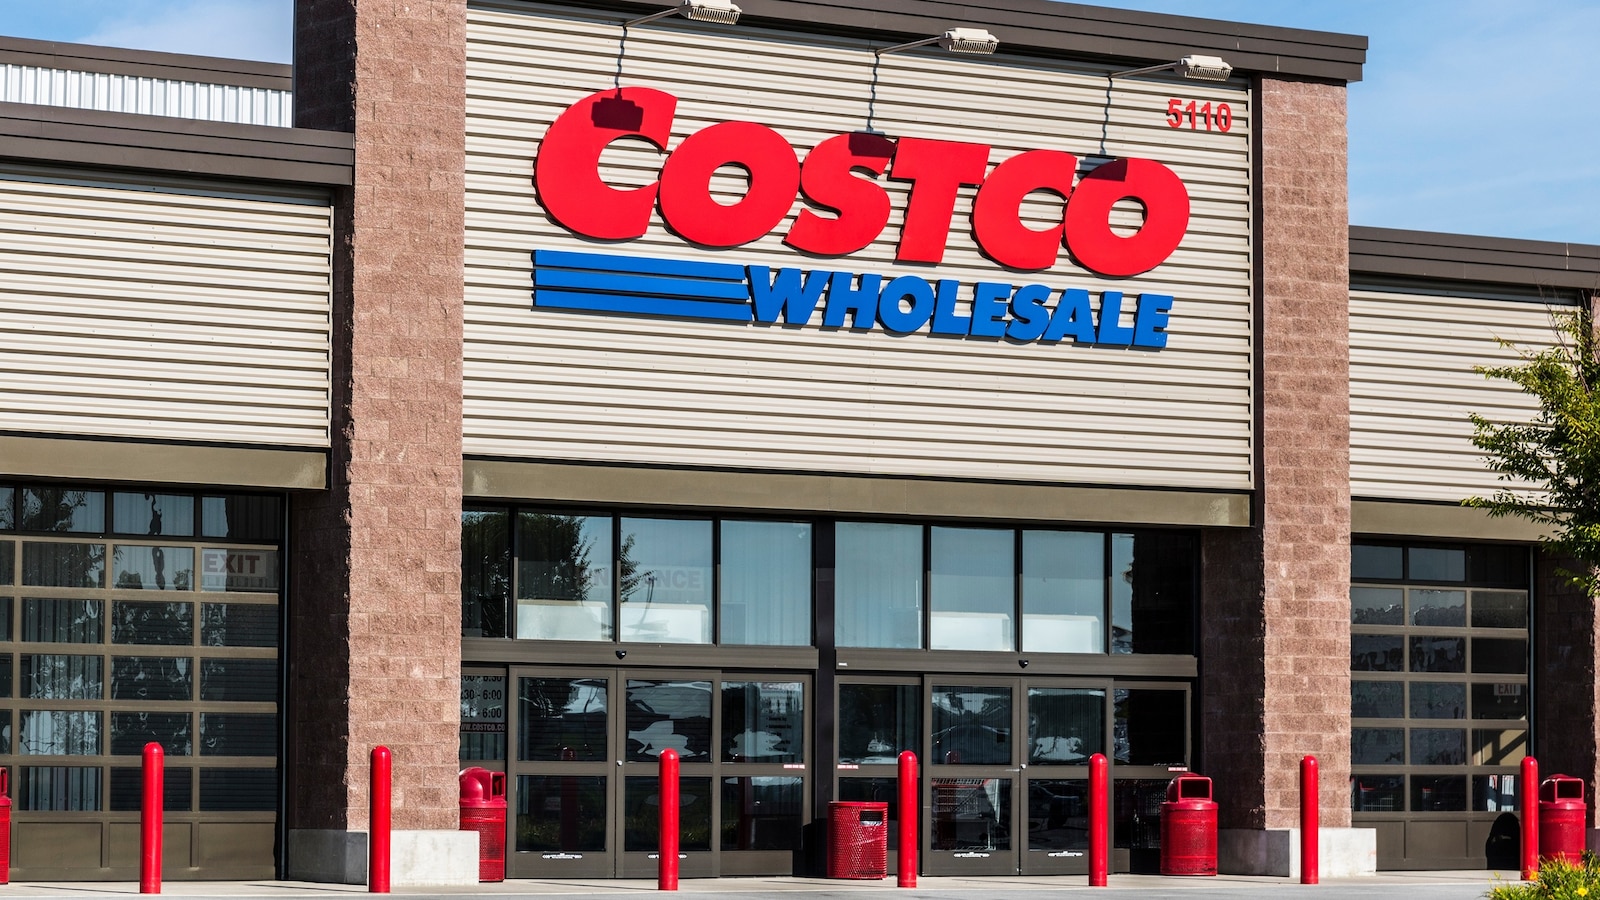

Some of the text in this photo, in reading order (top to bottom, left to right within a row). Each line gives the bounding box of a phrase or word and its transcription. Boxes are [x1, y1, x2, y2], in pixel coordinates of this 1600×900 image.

[1167, 98, 1232, 133] 5110
[535, 86, 1190, 277] COSTCO
[747, 265, 1174, 348] WHOLESALE
[204, 553, 261, 574] EXIT
[483, 690, 502, 700] 6:00
[1498, 683, 1517, 695] EXIT
[482, 708, 502, 718] 6:00
